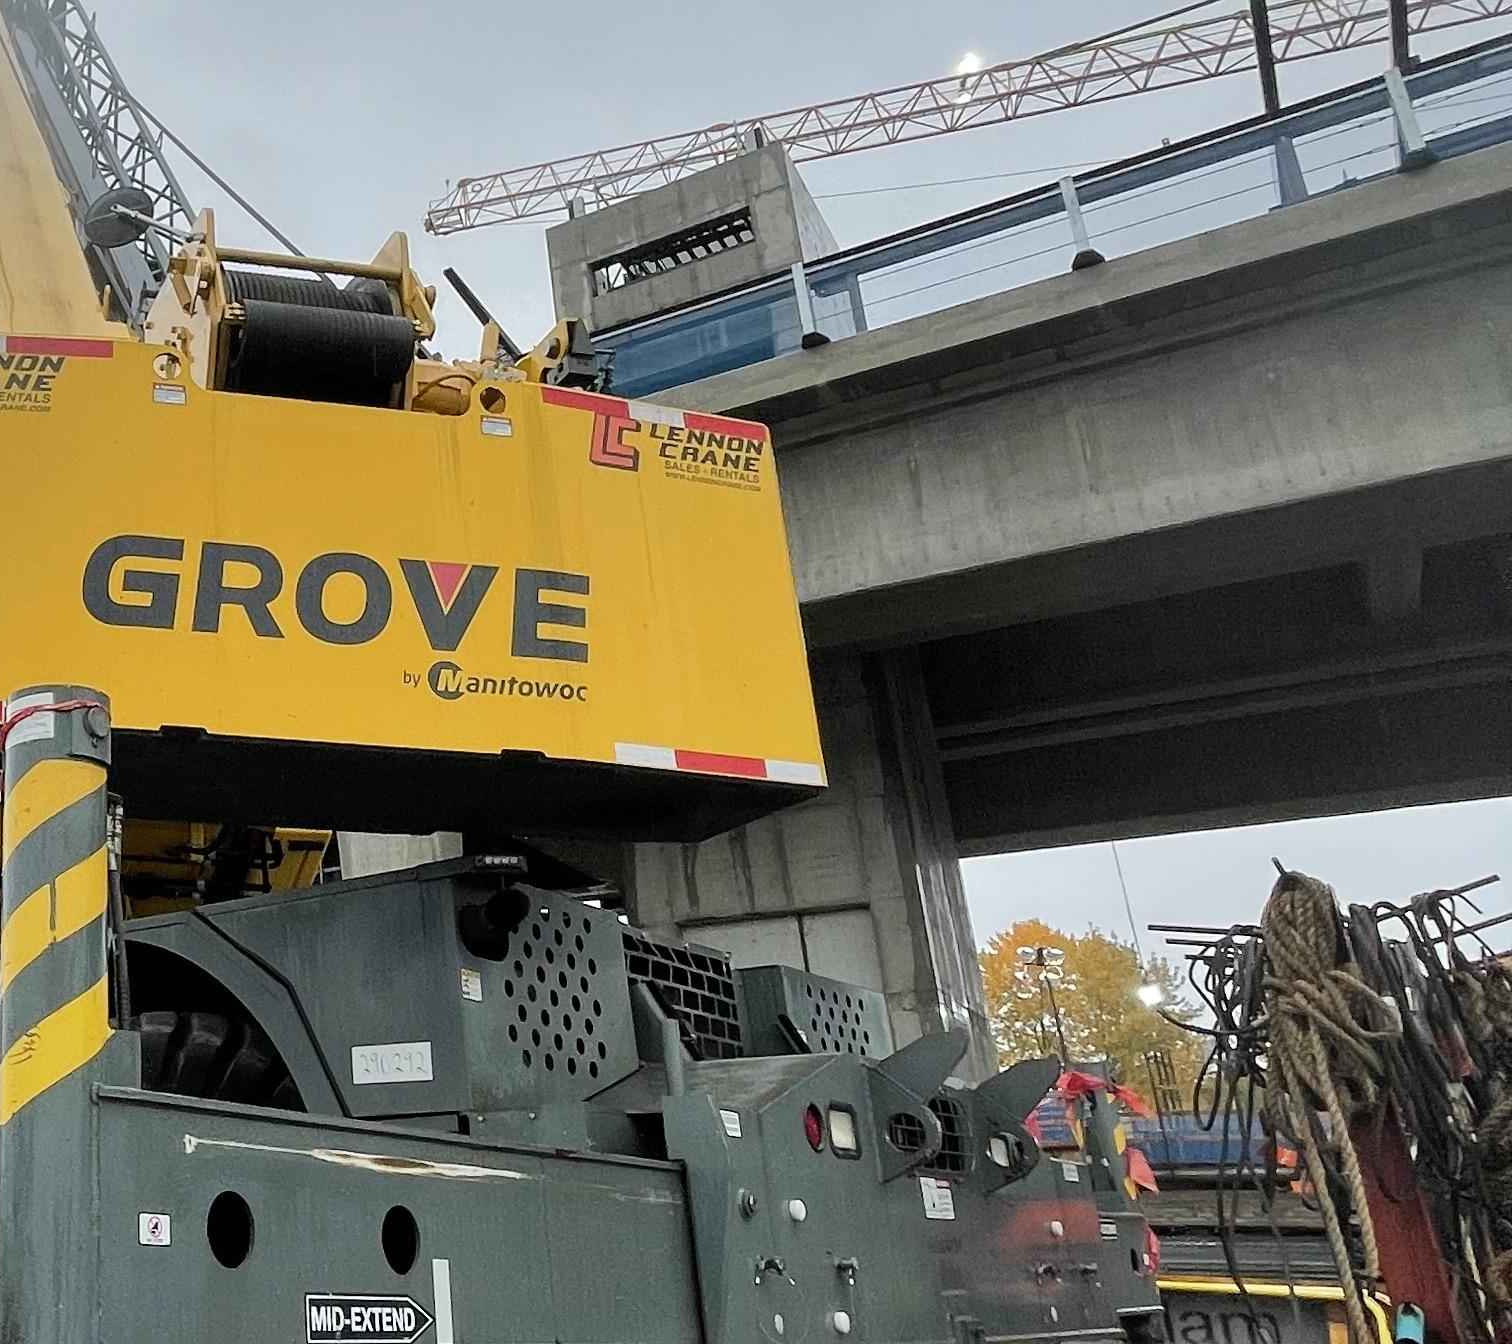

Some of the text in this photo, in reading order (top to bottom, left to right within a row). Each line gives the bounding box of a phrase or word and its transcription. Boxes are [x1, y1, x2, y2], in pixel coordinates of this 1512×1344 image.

[650, 423, 764, 455] LENNON
[659, 442, 761, 472] CRANE
[664, 459, 701, 474] SALES
[710, 466, 760, 484] RENTALS
[82, 534, 590, 663] GROVE
[402, 661, 587, 702] by Manitowoc
[310, 1305, 416, 1332] MID-EXTEND
